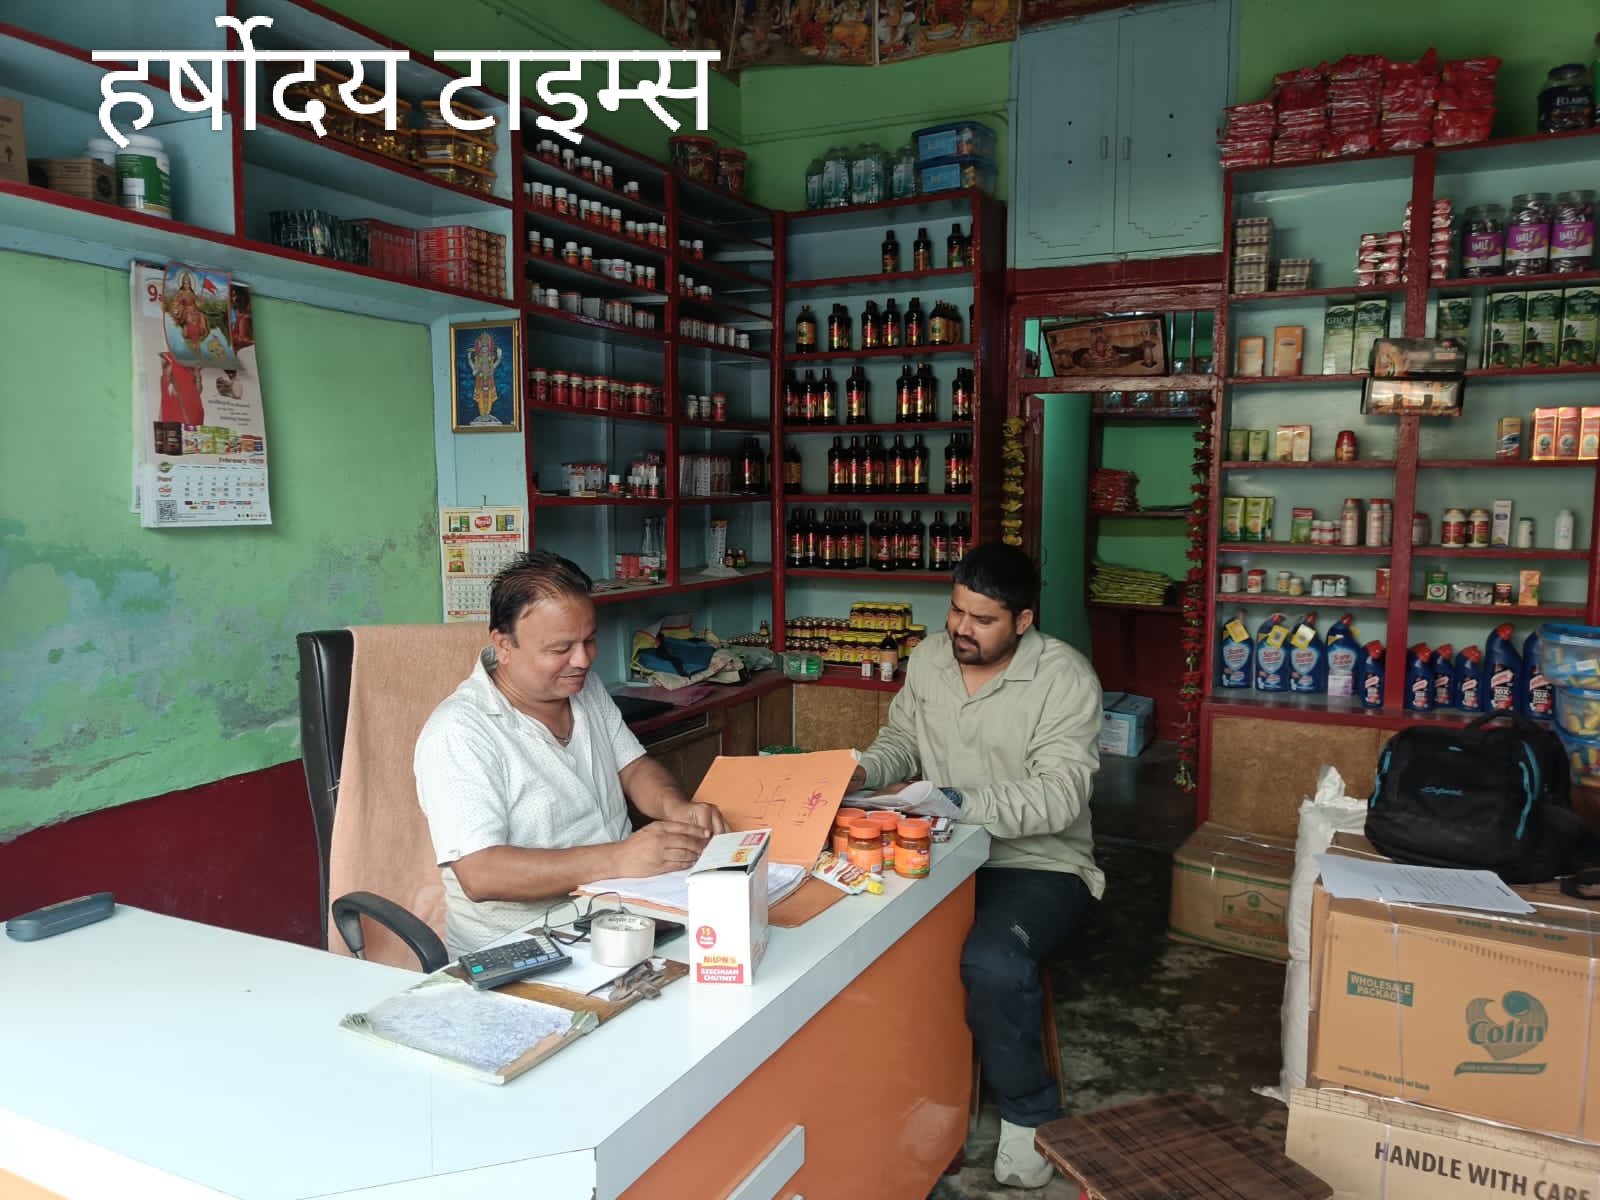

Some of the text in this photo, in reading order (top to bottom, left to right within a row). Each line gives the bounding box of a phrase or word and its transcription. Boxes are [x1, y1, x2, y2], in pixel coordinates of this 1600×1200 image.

[1351, 974, 1412, 995] WHOLESALE
[1468, 1019, 1545, 1044] Colin
[1374, 1141, 1462, 1180] HANDLE
[1468, 1162, 1528, 1196] WITH
